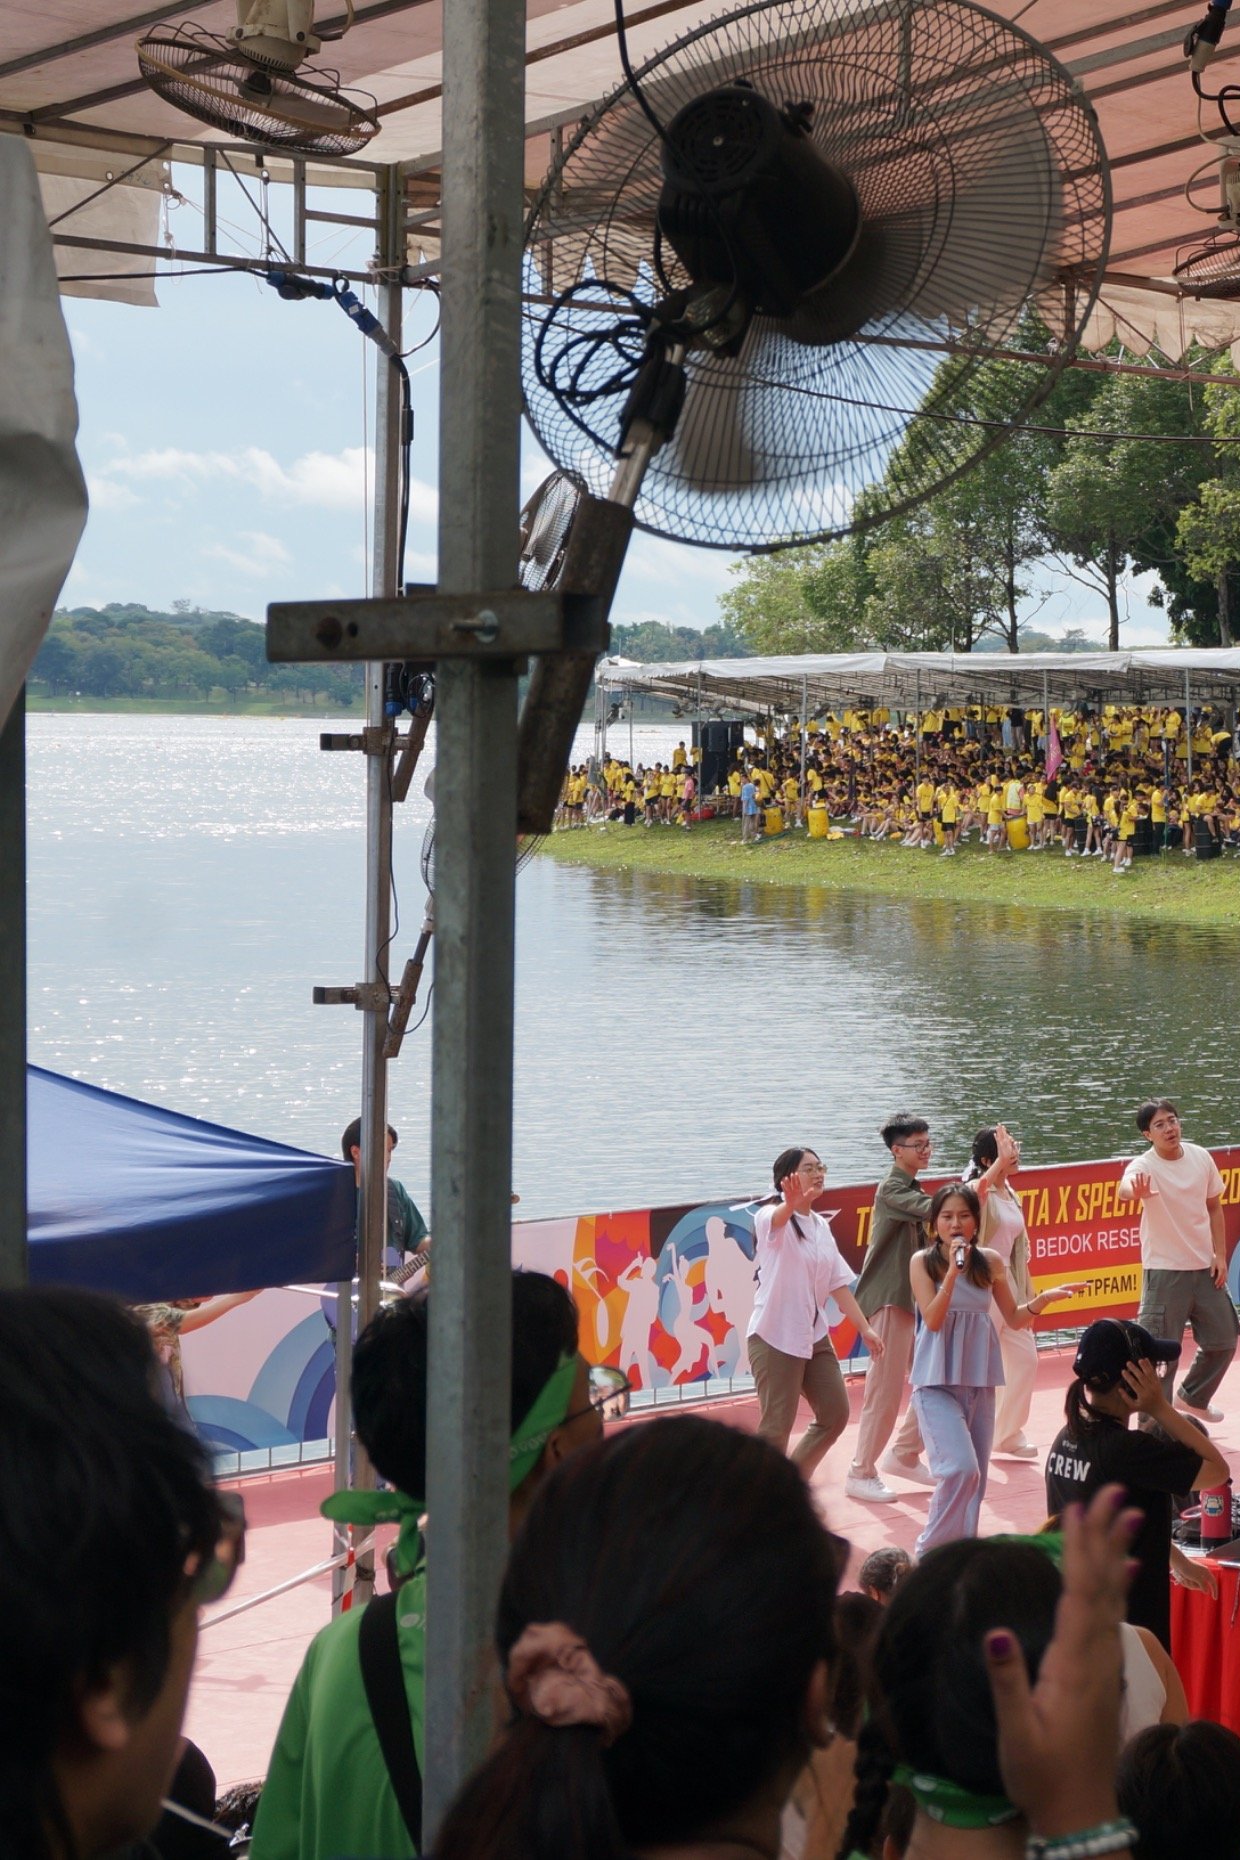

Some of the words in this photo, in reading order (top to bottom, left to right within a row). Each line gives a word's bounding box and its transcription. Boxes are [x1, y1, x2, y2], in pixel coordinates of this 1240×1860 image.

[1055, 1185, 1072, 1224] X
[1036, 1233, 1093, 1259] BEDOK
[1097, 1227, 1141, 1251] RESE
[1047, 1452, 1092, 1482] CREW
